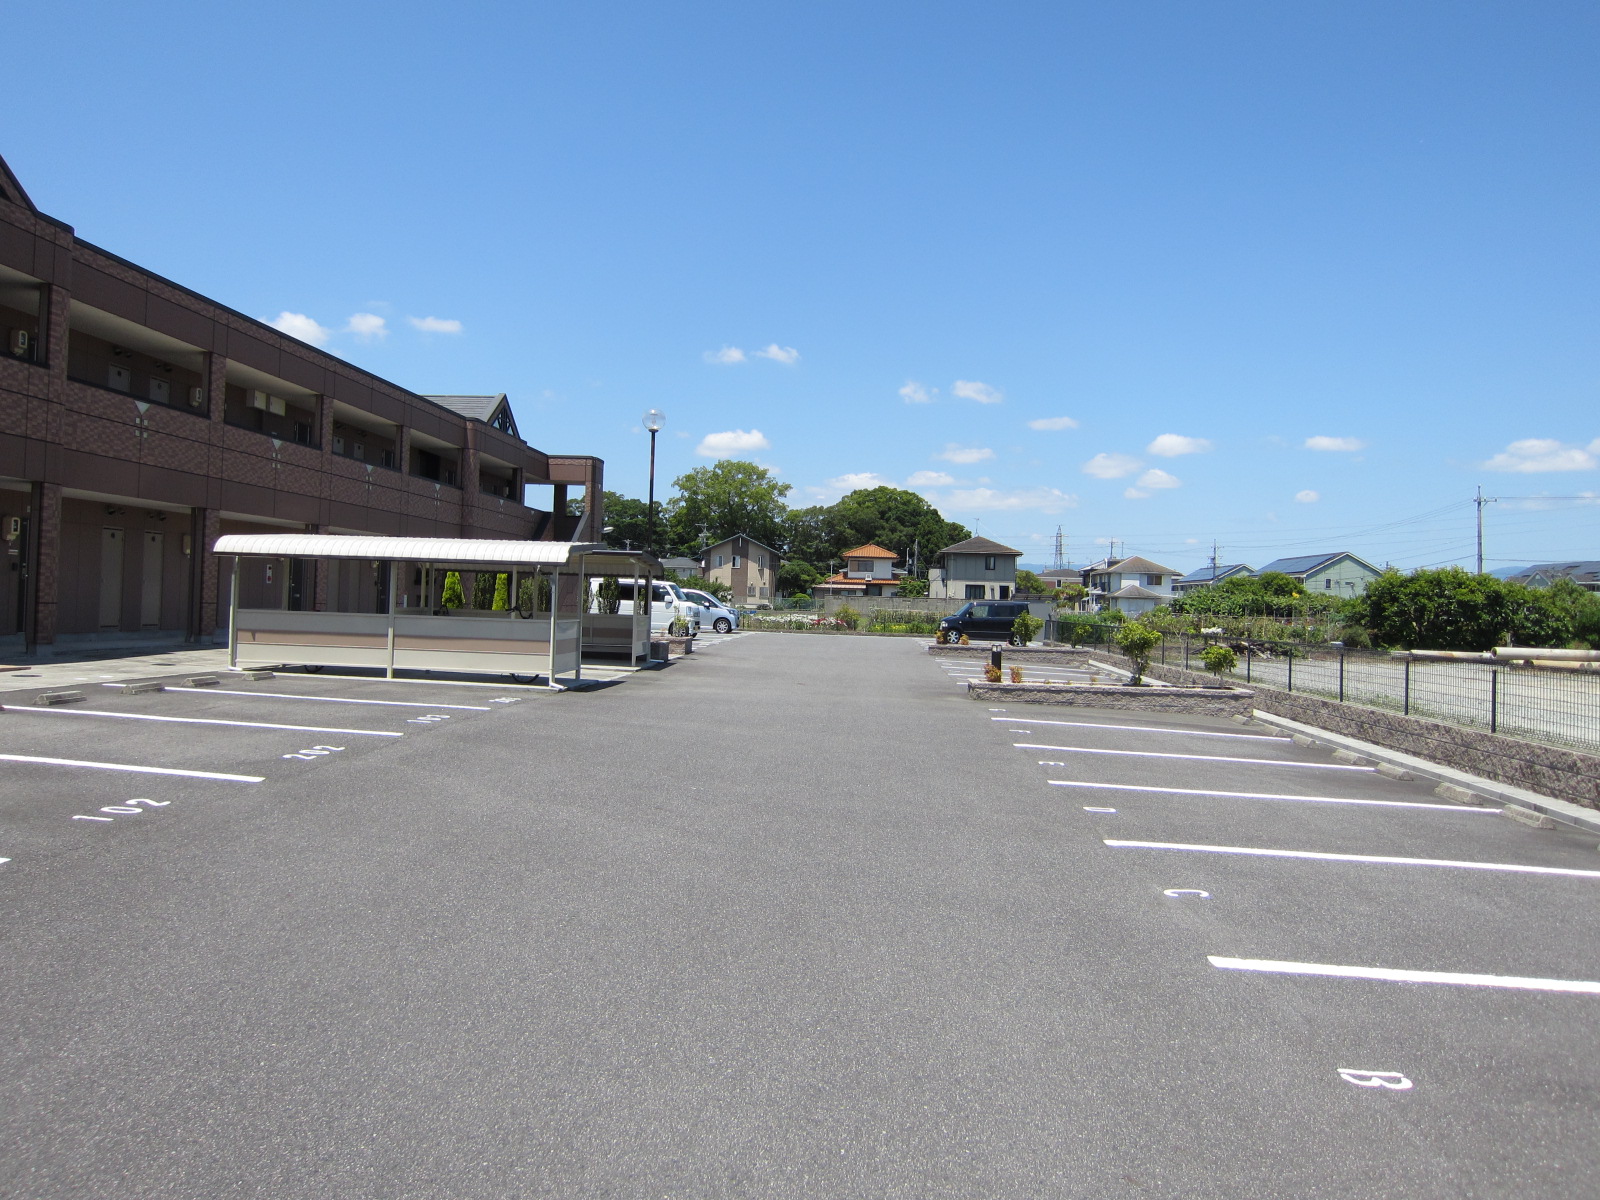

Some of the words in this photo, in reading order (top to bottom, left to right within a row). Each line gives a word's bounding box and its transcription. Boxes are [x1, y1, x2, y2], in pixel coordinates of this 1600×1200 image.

[282, 745, 346, 760] 202
[71, 798, 172, 822] 102
[1163, 888, 1210, 898] C
[1336, 1067, 1414, 1091] B
